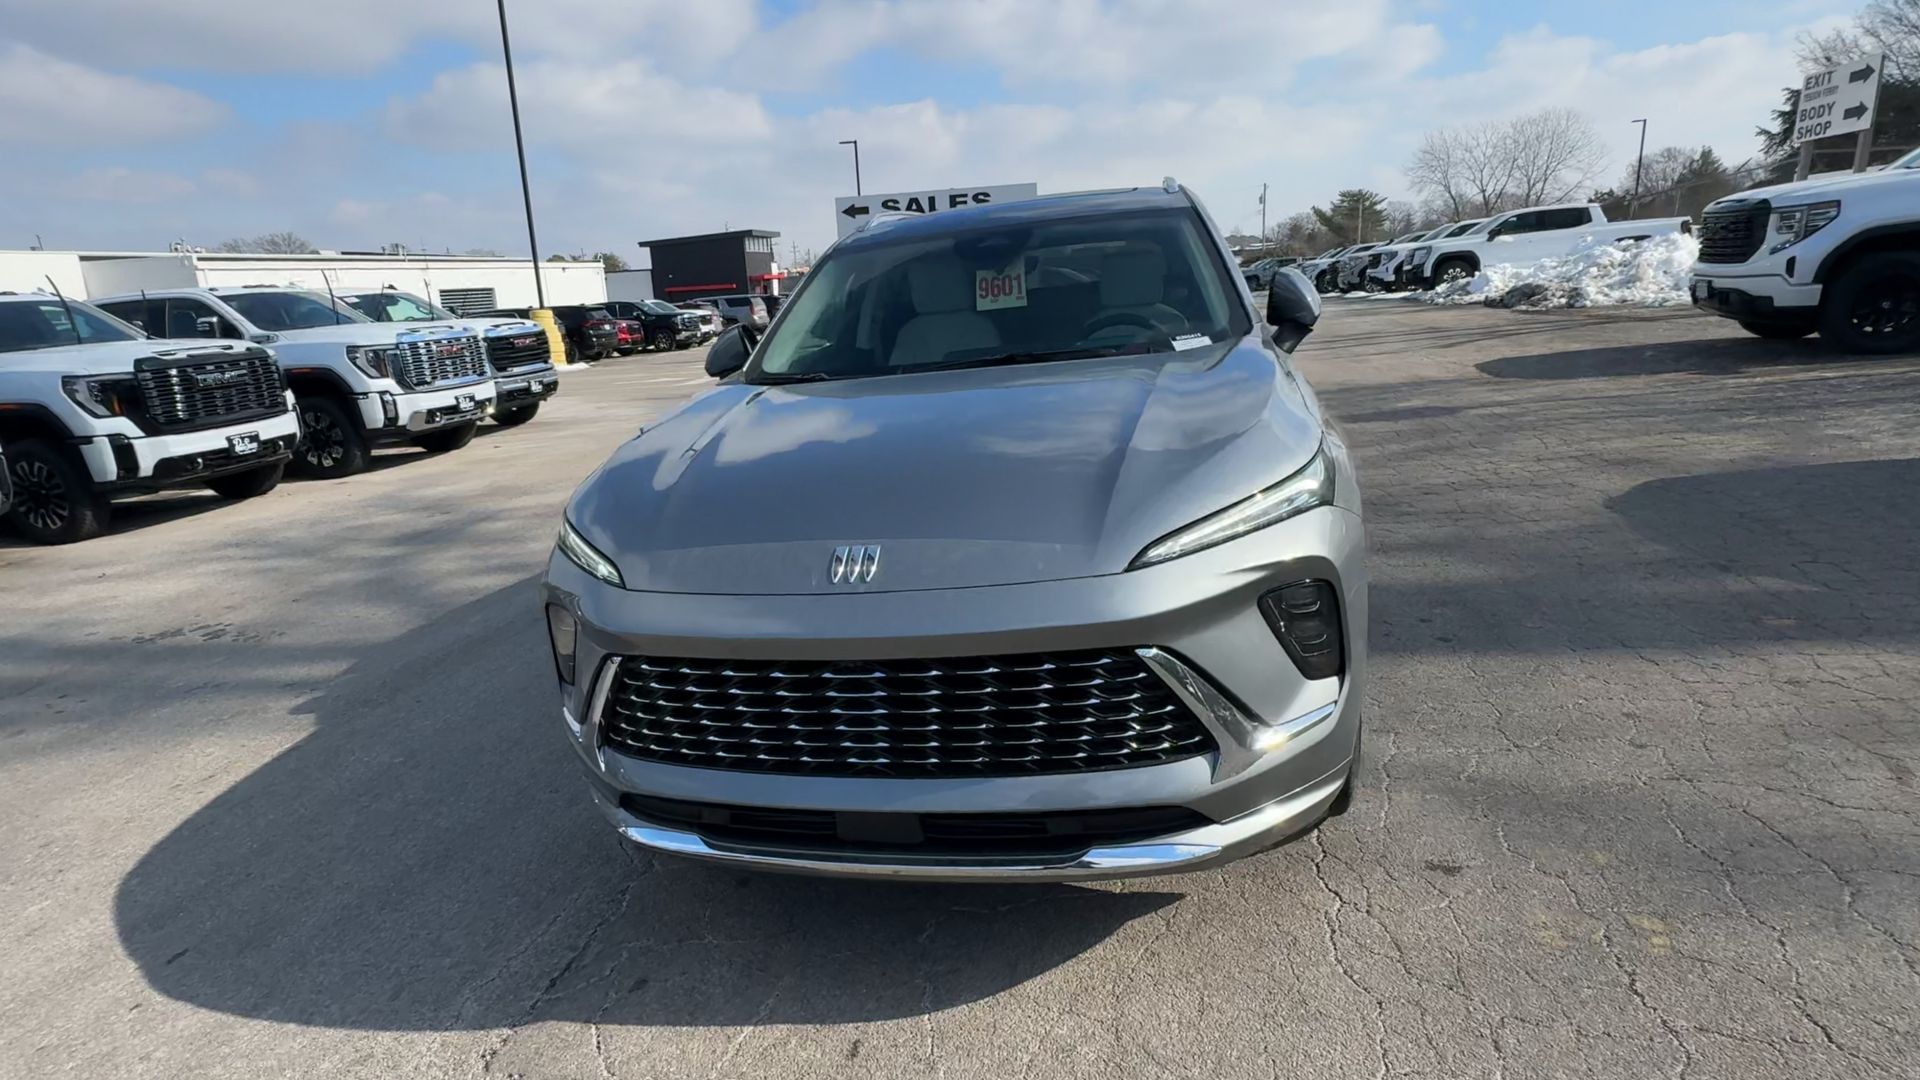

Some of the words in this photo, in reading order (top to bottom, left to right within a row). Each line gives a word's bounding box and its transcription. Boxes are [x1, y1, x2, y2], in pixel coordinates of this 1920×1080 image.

[1805, 70, 1836, 90] EXIT
[1799, 101, 1836, 122] BODY
[1796, 121, 1832, 140] SHOP
[979, 273, 1023, 299] 9601
